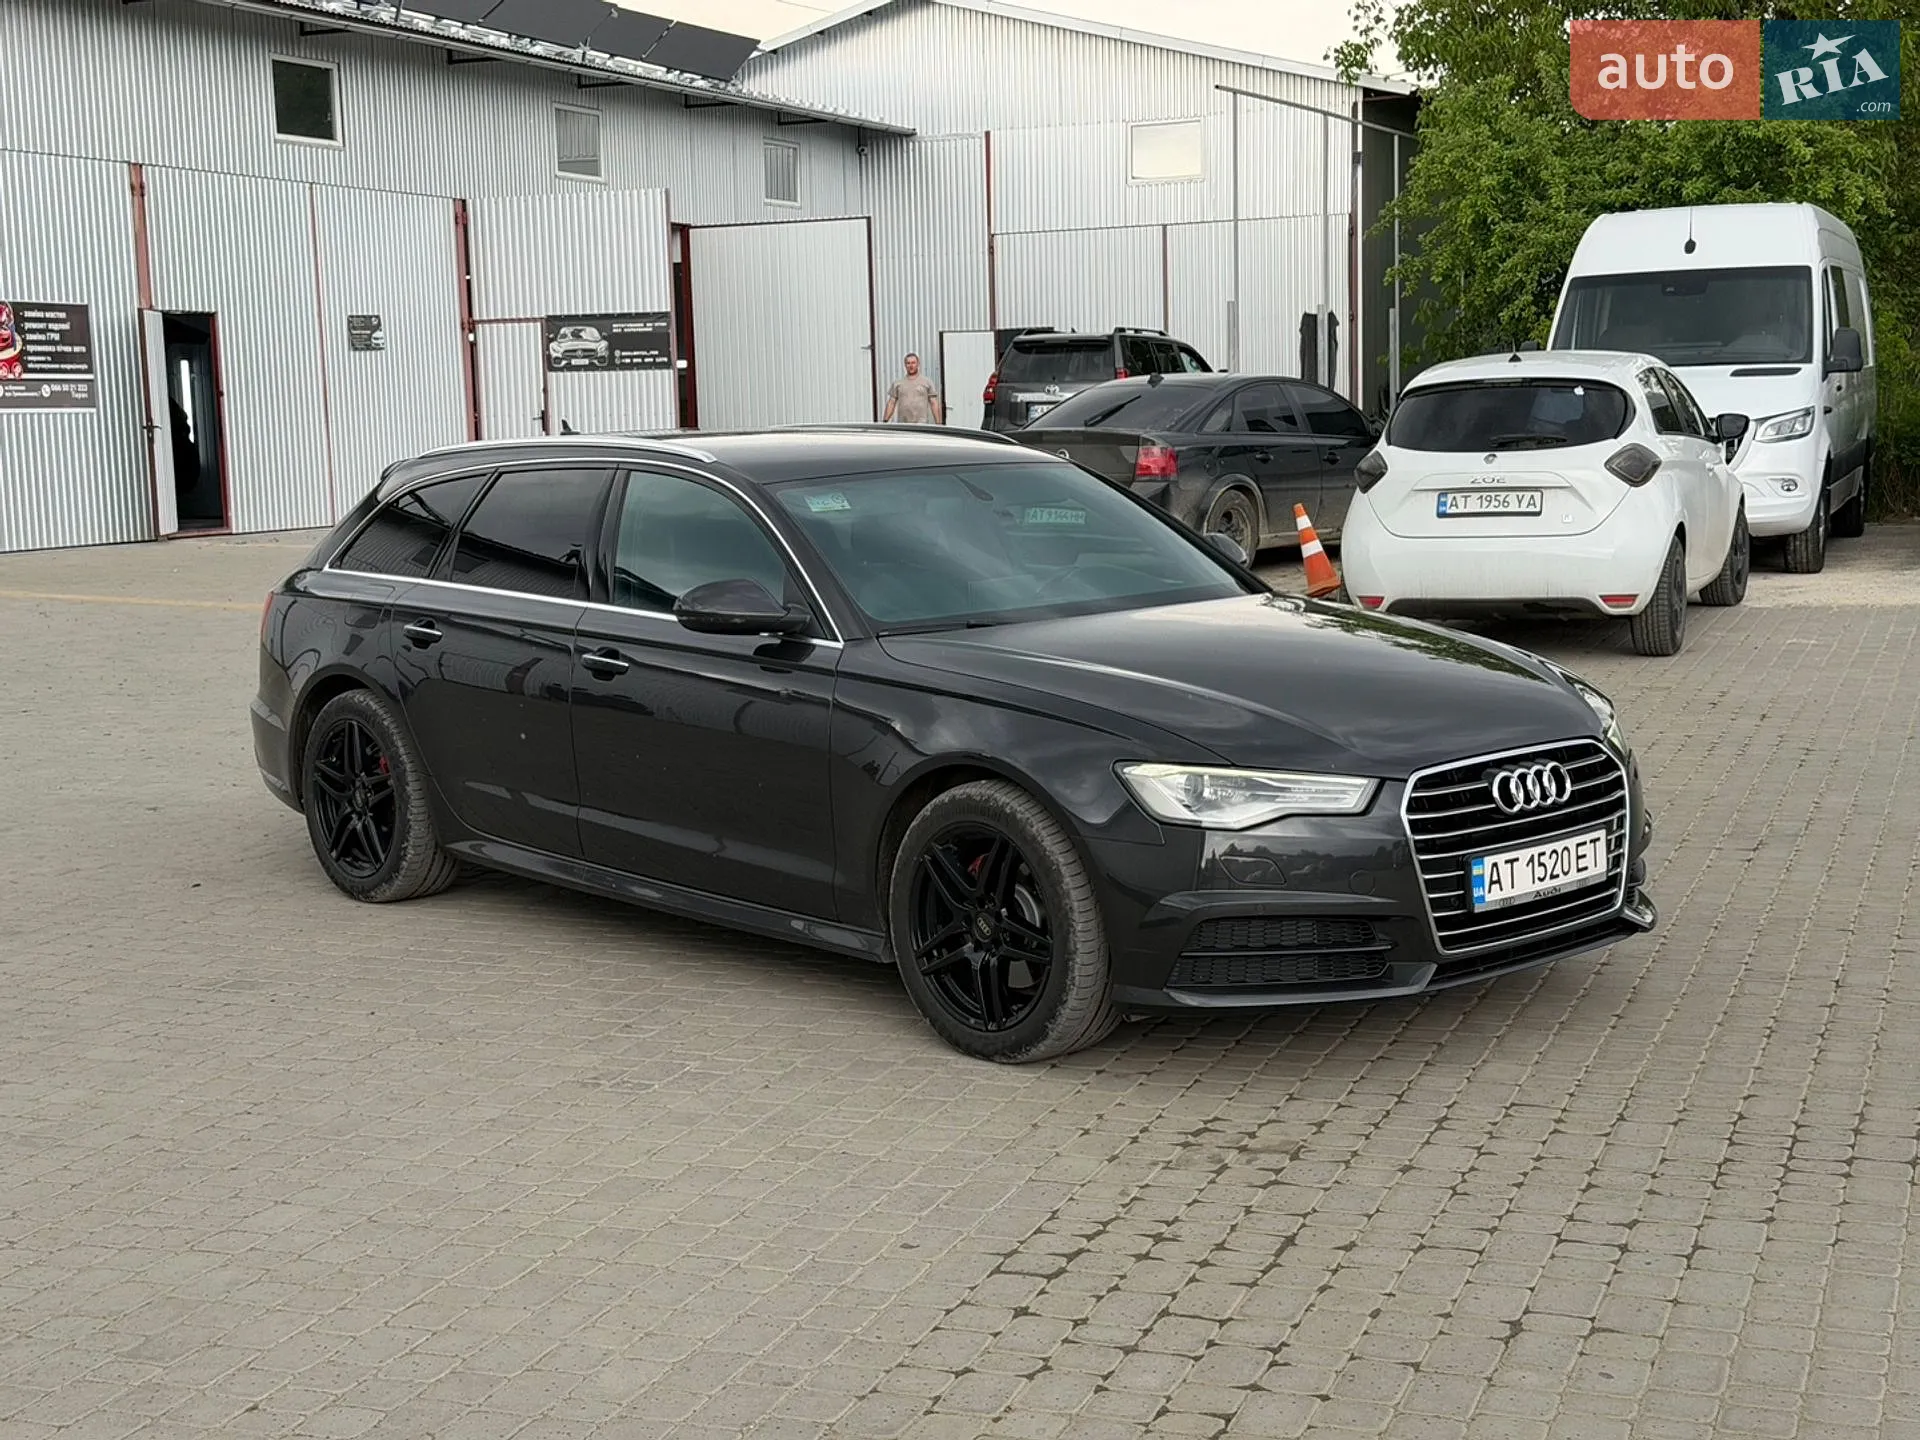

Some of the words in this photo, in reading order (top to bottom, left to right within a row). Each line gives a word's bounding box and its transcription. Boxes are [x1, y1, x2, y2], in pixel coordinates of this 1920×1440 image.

[1448, 494, 1471, 510] AT
[1476, 494, 1511, 509] 1956
[1516, 494, 1538, 509] YA
[1473, 887, 1484, 898] UA
[1487, 857, 1520, 895] AT
[1525, 846, 1571, 886] 1520
[1575, 836, 1601, 874] ET
